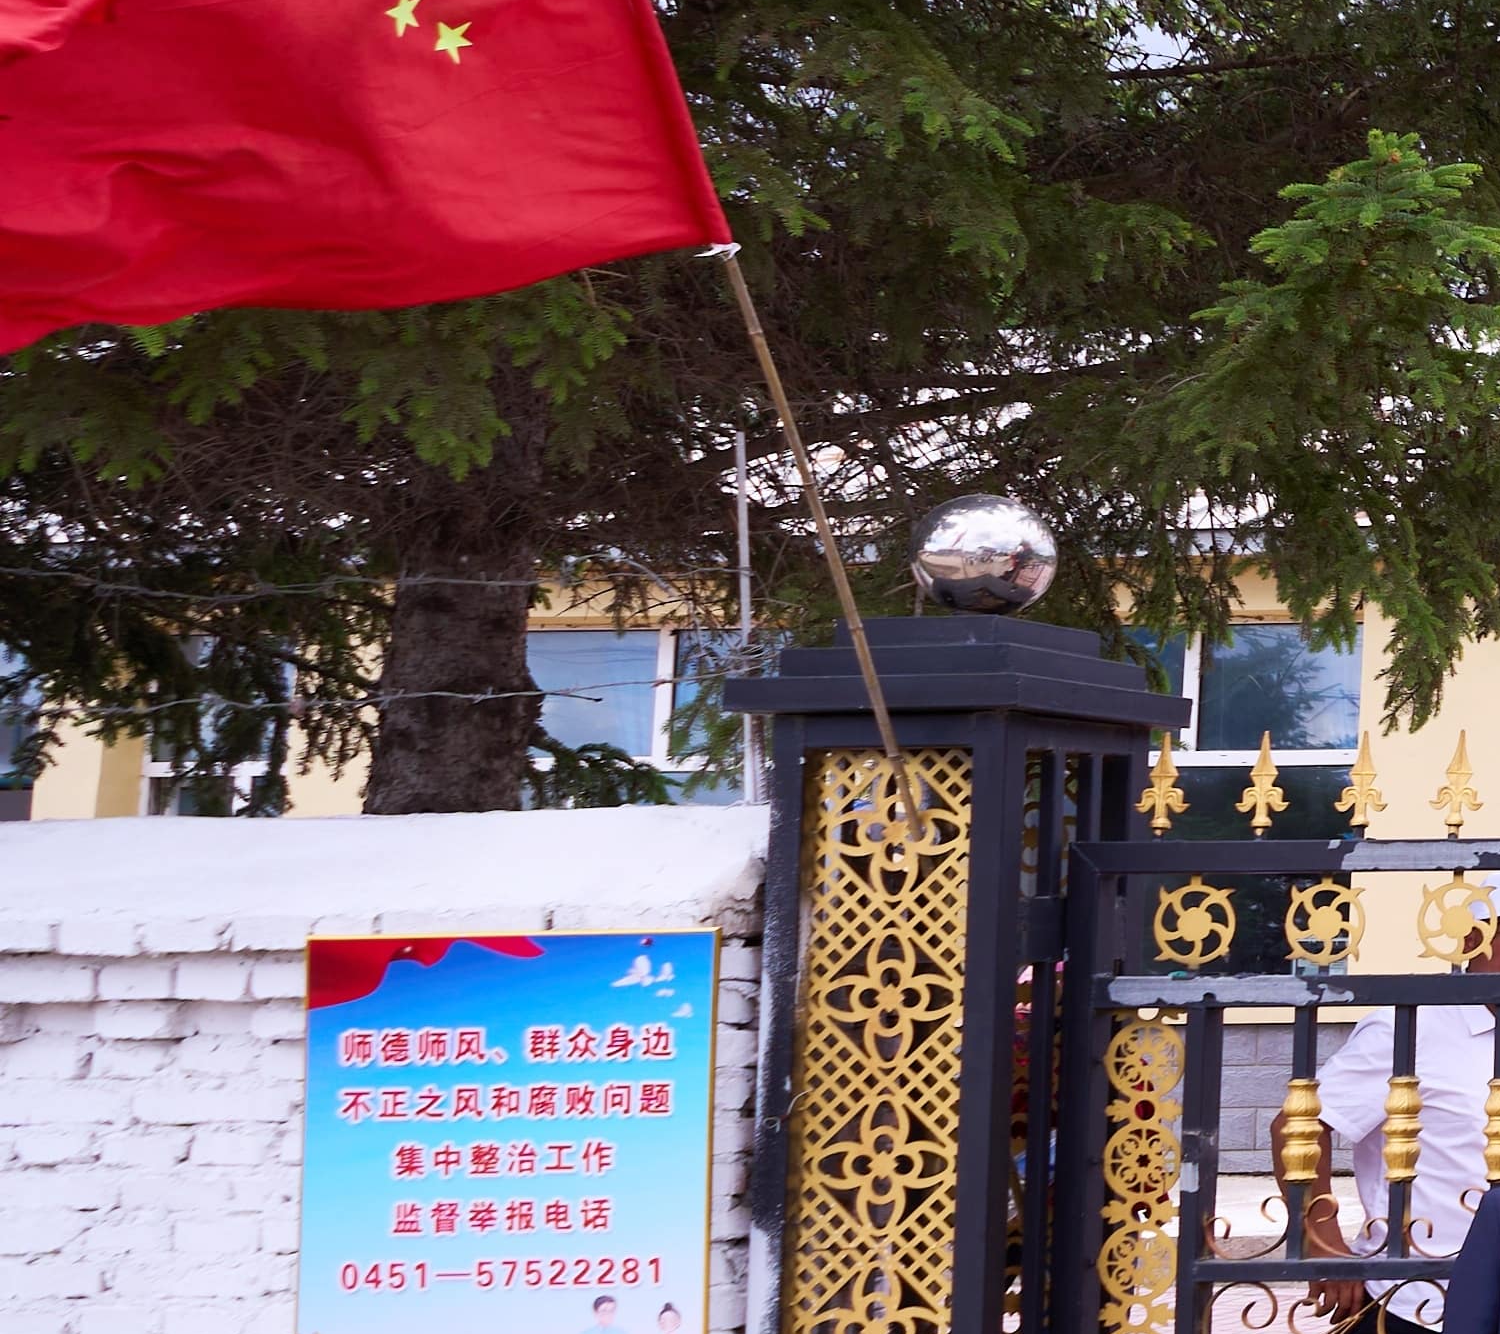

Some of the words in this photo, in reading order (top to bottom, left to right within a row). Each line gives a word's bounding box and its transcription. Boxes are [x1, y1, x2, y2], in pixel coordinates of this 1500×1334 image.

[341, 1026, 676, 1065] 师德师风、群众身边
[341, 1082, 673, 1121] 不正之风和腐败问题
[393, 1140, 615, 1178] 集中整治工作
[391, 1198, 613, 1236] 监督举报电话
